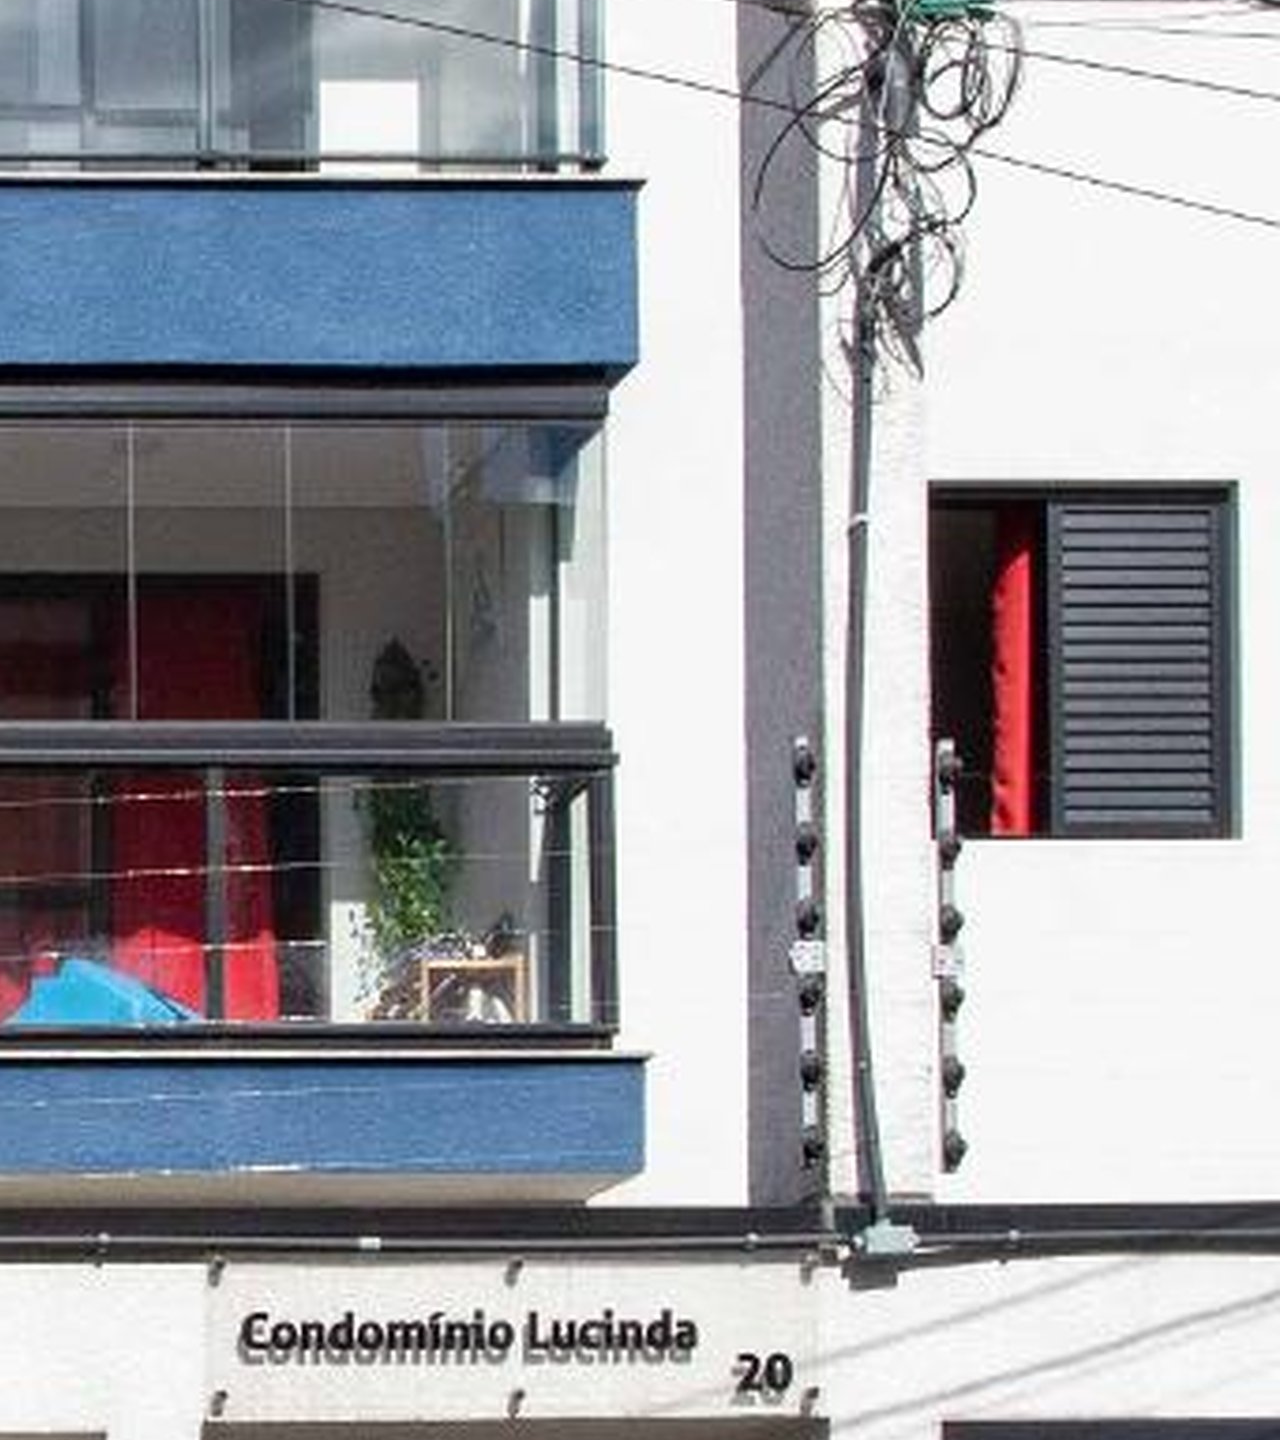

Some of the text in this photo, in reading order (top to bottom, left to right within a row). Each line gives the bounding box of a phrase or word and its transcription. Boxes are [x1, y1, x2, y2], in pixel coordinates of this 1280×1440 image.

[241, 1309, 698, 1351] Condomínio Lucinda
[739, 1353, 794, 1391] 20
